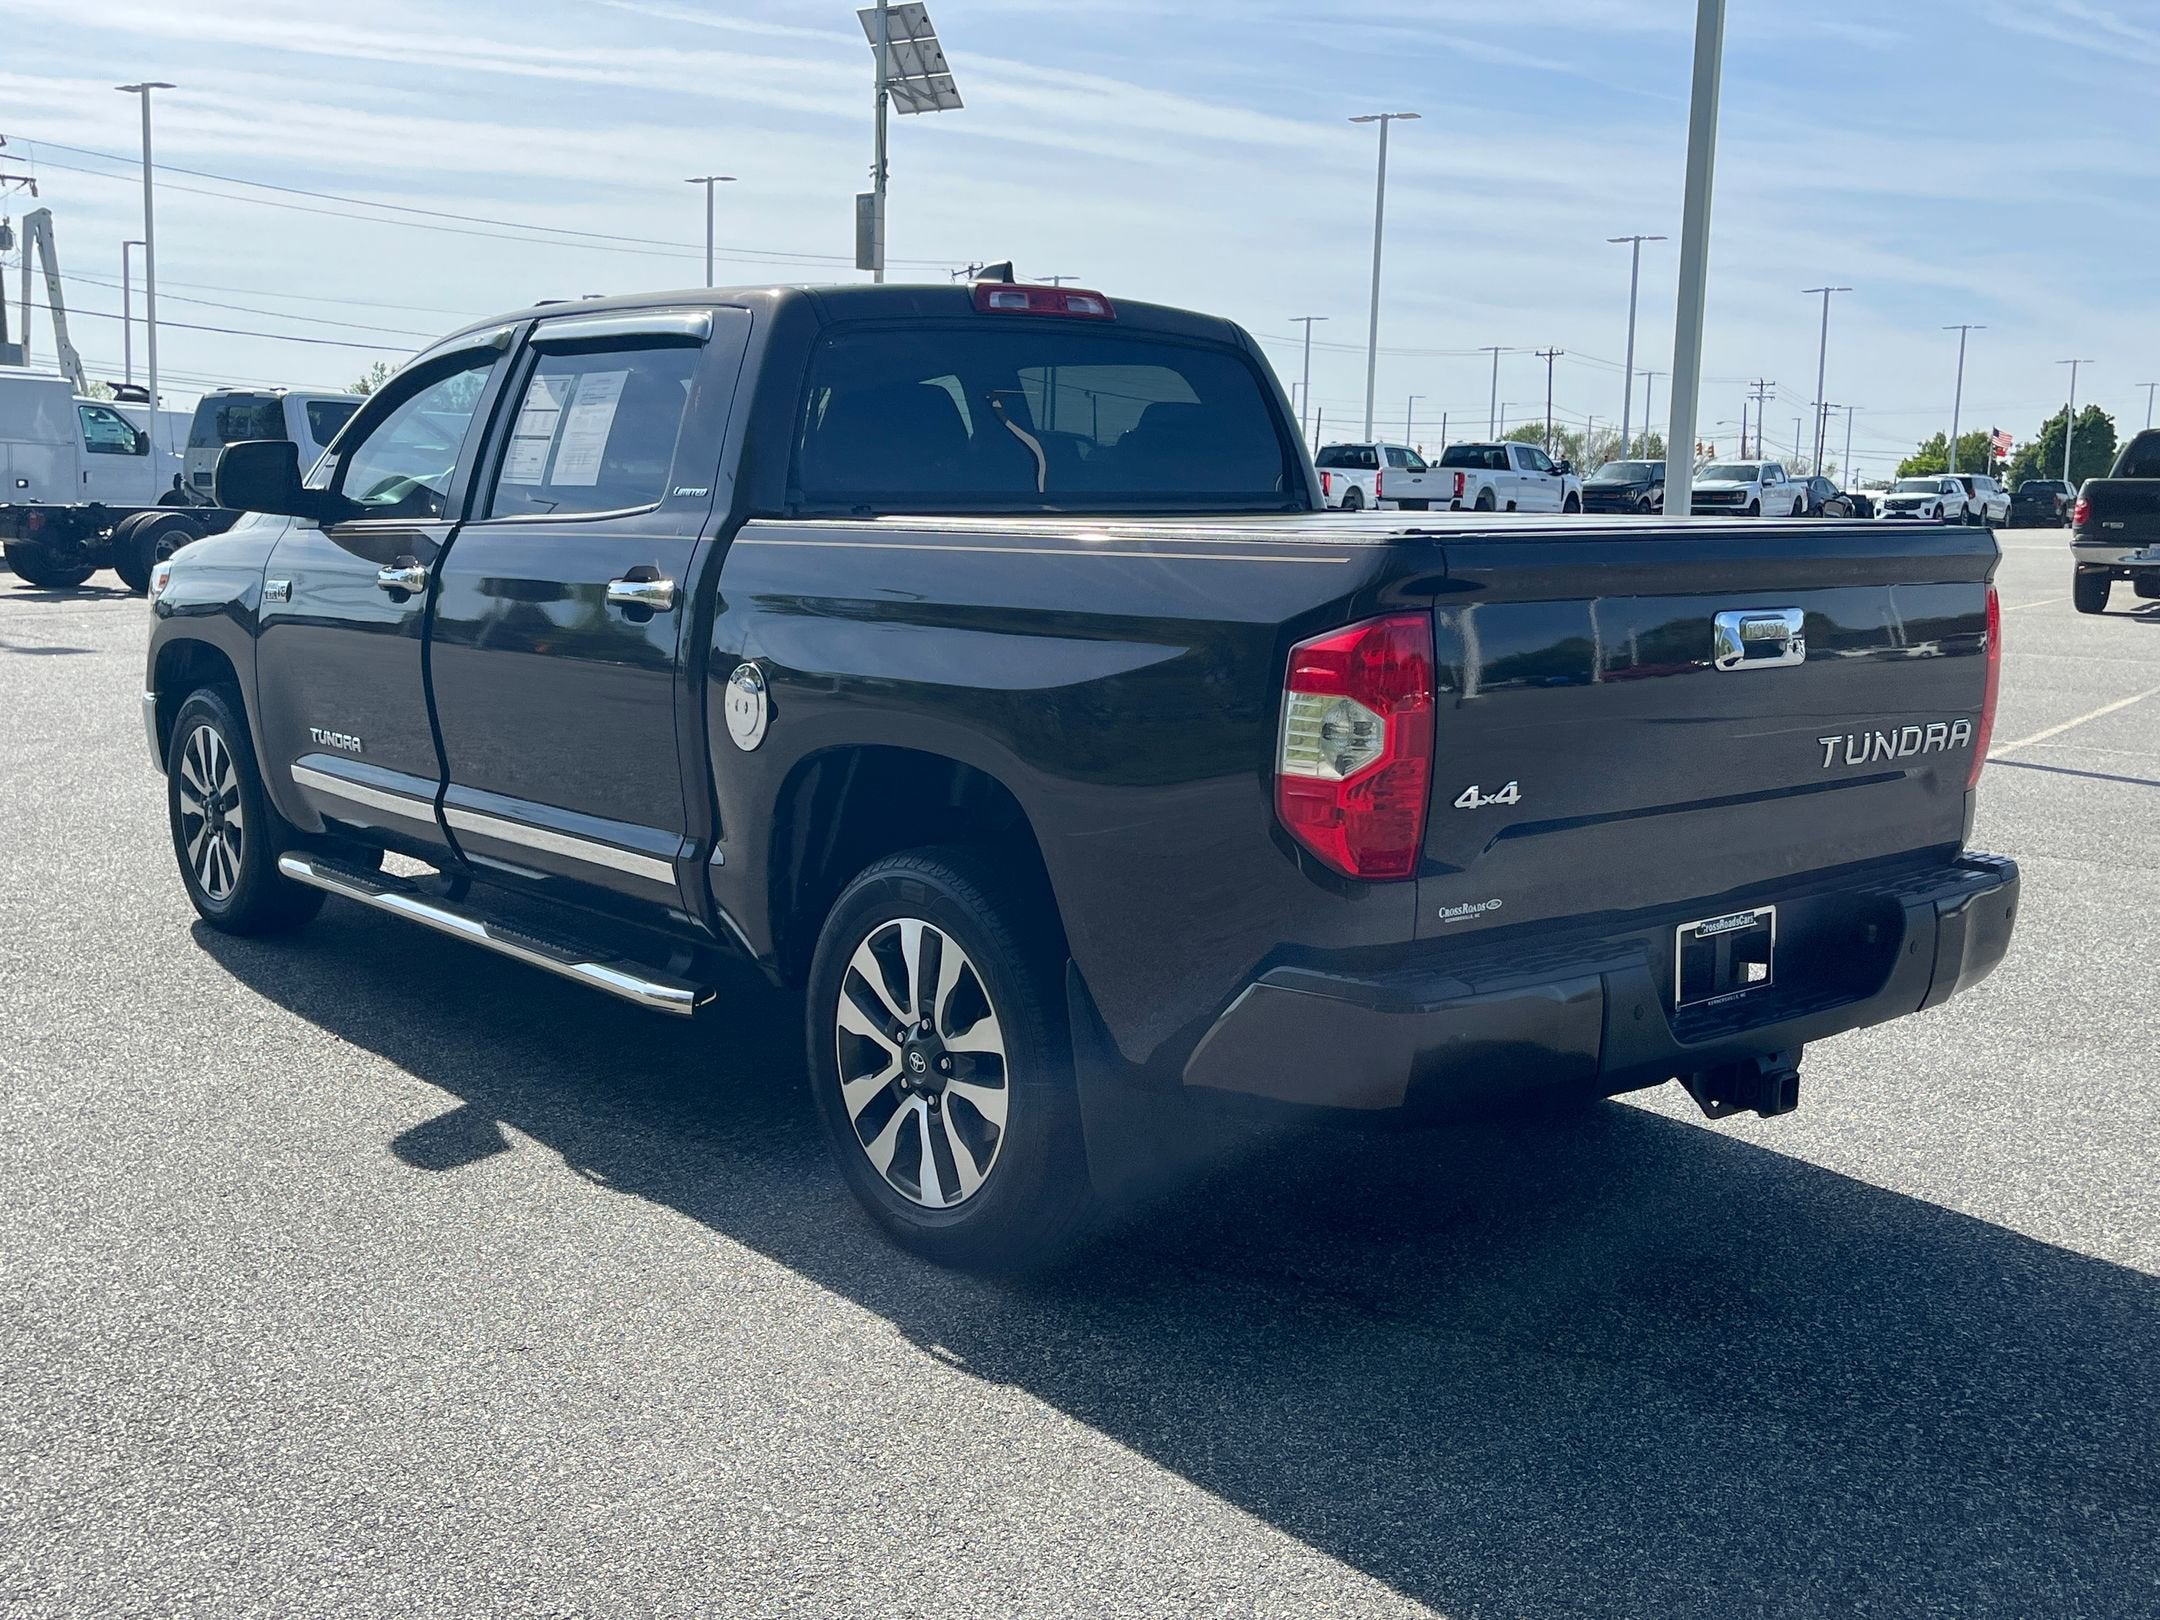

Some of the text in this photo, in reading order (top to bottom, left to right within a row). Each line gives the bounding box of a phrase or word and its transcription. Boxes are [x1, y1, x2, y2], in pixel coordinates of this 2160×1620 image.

[1747, 622, 1788, 637] TOYOTA
[309, 727, 362, 753] TUNDRA
[1817, 718, 1972, 768] TUNDRA
[1454, 780, 1522, 809] 4x4
